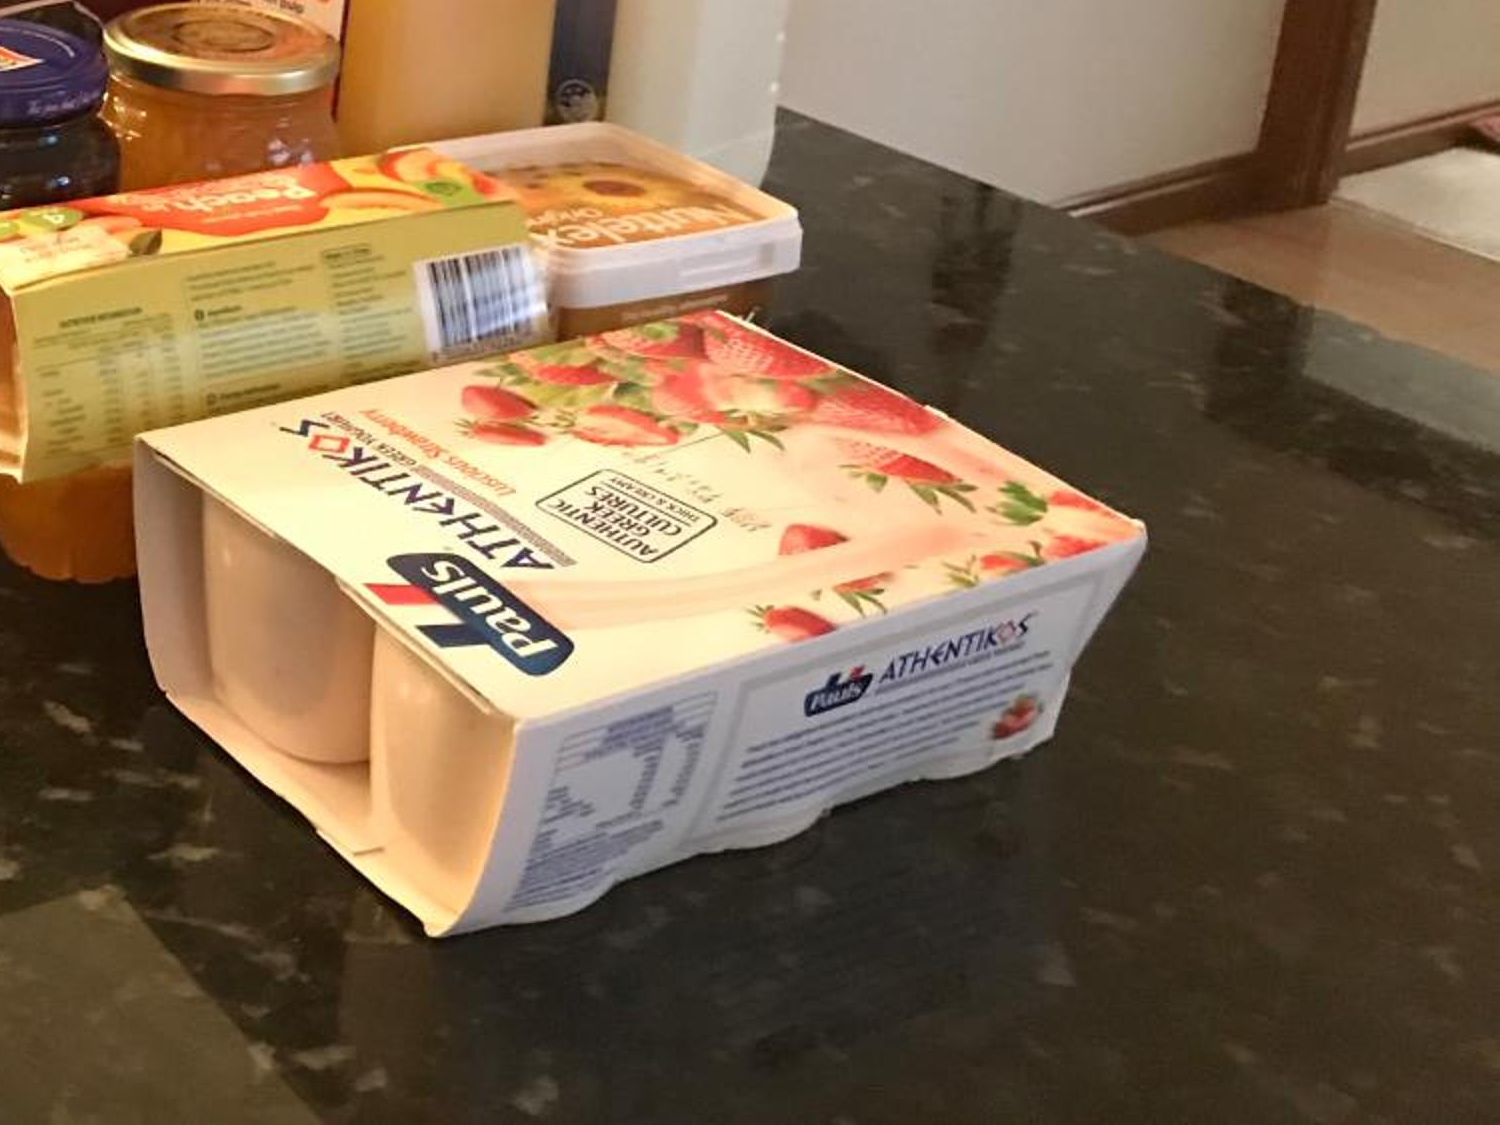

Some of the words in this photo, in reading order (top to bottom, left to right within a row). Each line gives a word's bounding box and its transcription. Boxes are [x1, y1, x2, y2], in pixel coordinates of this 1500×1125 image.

[529, 201, 745, 255] Nuttelex
[358, 409, 441, 458] Strawberry
[279, 419, 555, 569] ATHENTIKOS
[444, 455, 517, 497] Luscious
[609, 477, 657, 500] CREAMY
[548, 498, 658, 556] AUTHENTIC
[584, 486, 682, 536] CULTURES
[584, 501, 650, 537] GREEK
[668, 504, 700, 522] THICK
[879, 612, 1036, 684] ATHENTIKOS
